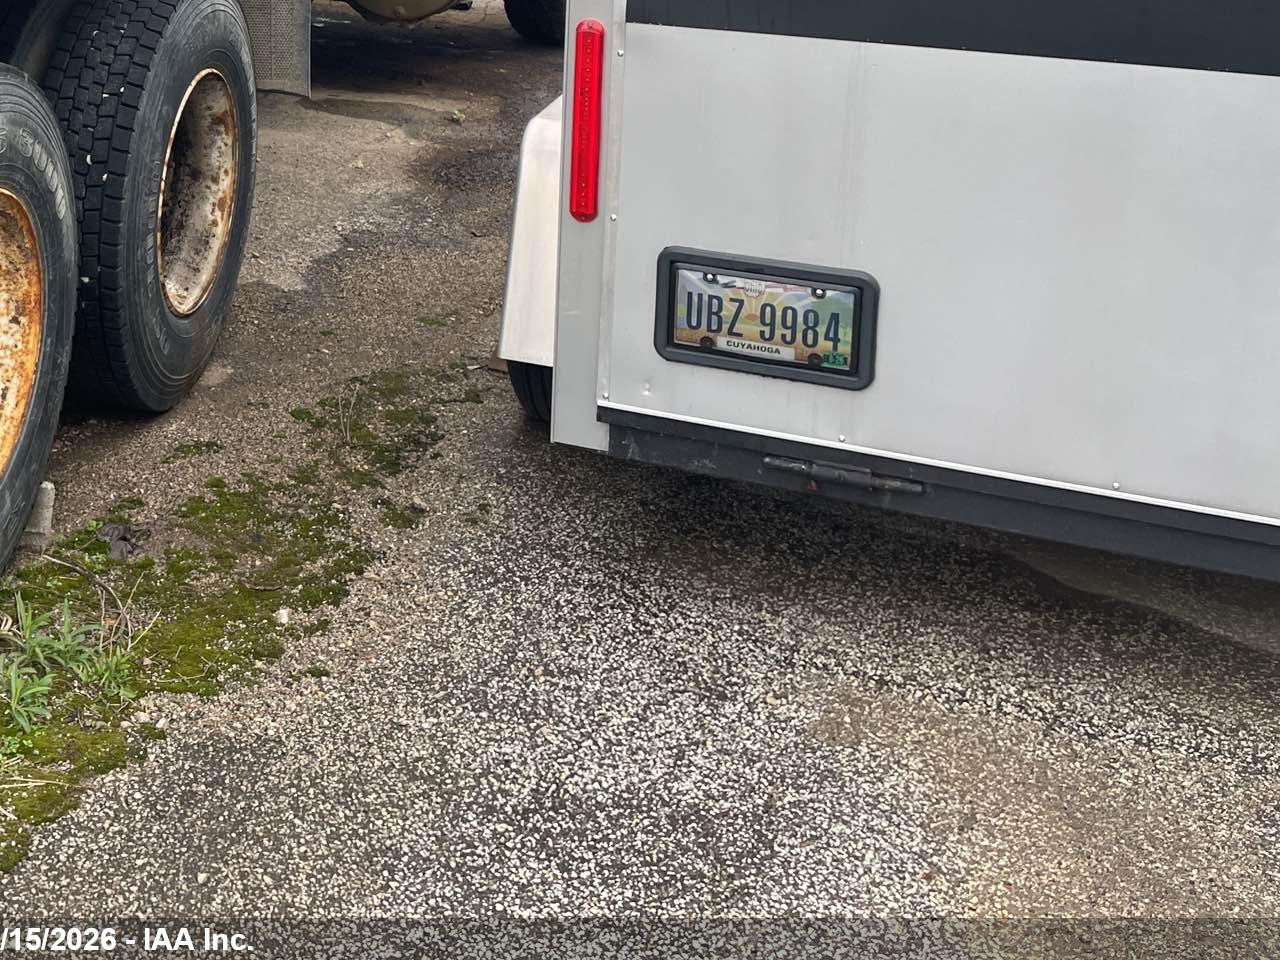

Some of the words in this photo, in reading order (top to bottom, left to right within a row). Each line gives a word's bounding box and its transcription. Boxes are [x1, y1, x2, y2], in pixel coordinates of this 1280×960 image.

[686, 291, 745, 338] UBZ
[759, 302, 841, 352] 9984
[726, 339, 782, 355] CUYAHOGA
